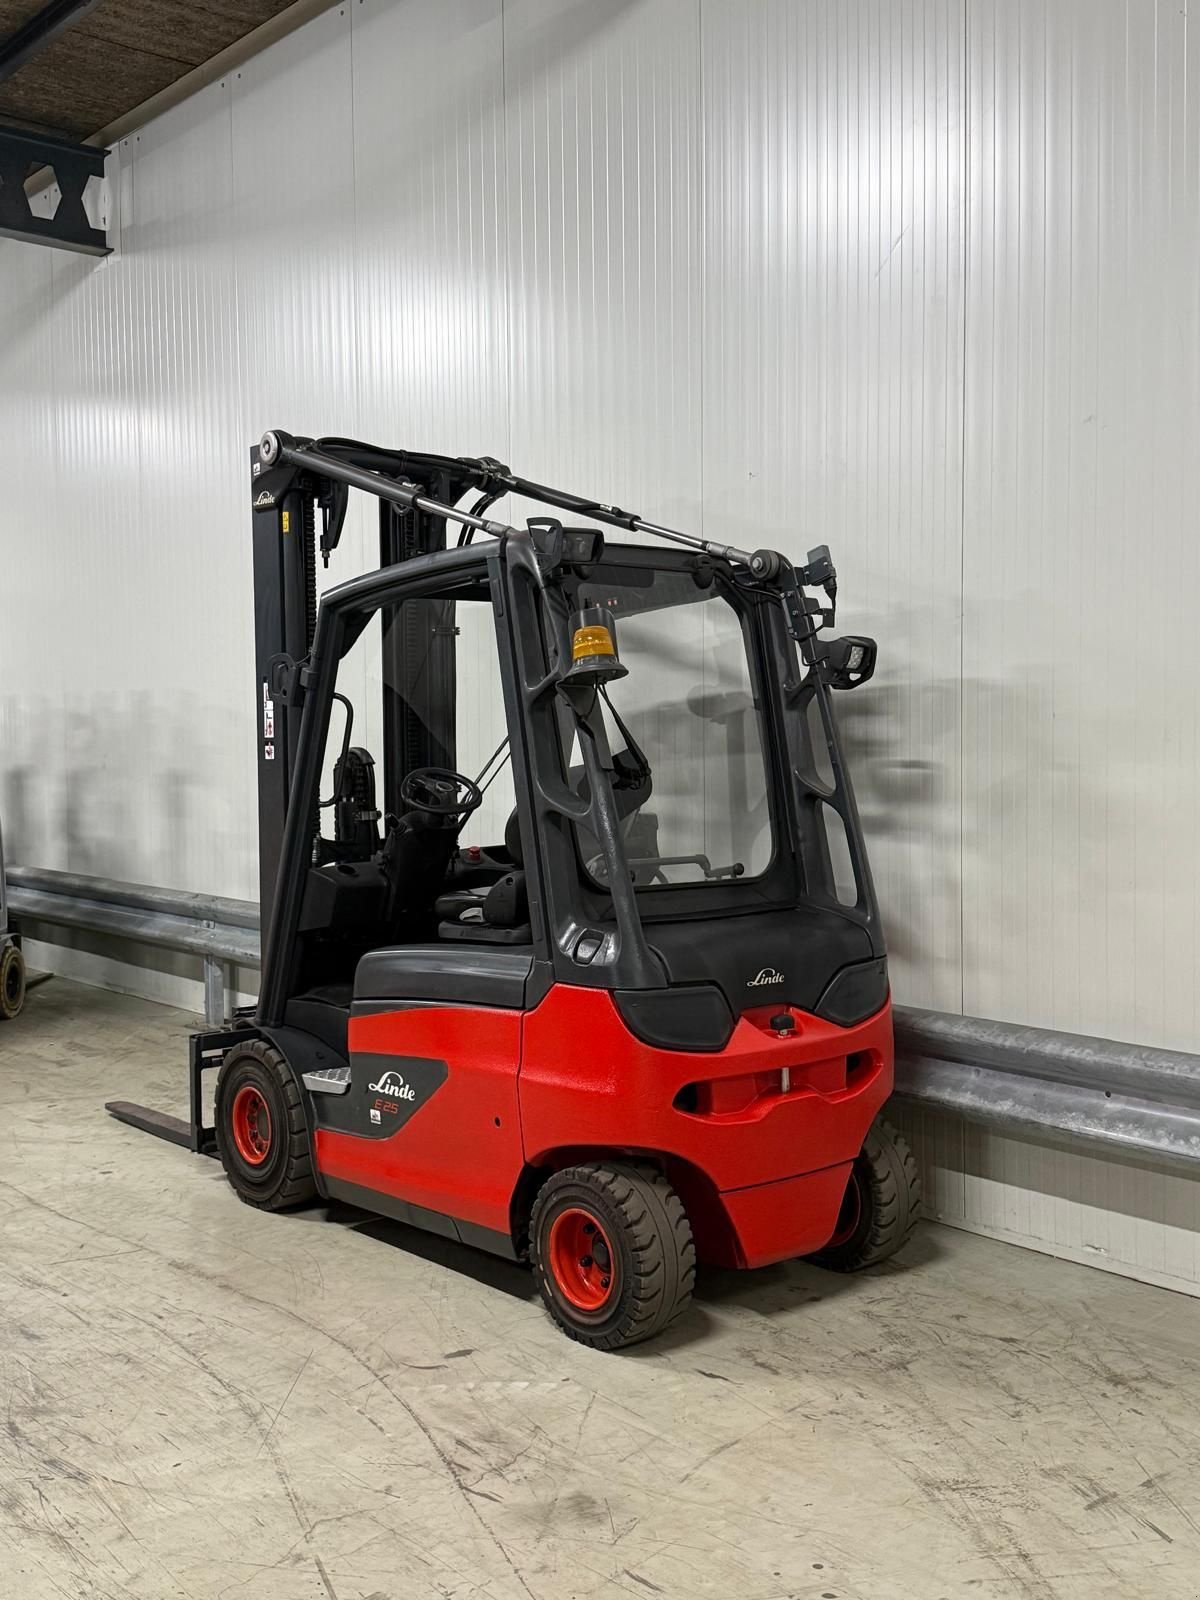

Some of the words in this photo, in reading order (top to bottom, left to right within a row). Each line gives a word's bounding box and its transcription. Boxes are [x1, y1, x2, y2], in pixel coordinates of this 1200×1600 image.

[253, 490, 275, 506] Linde
[746, 967, 785, 987] Linde
[368, 1071, 416, 1101] Linde
